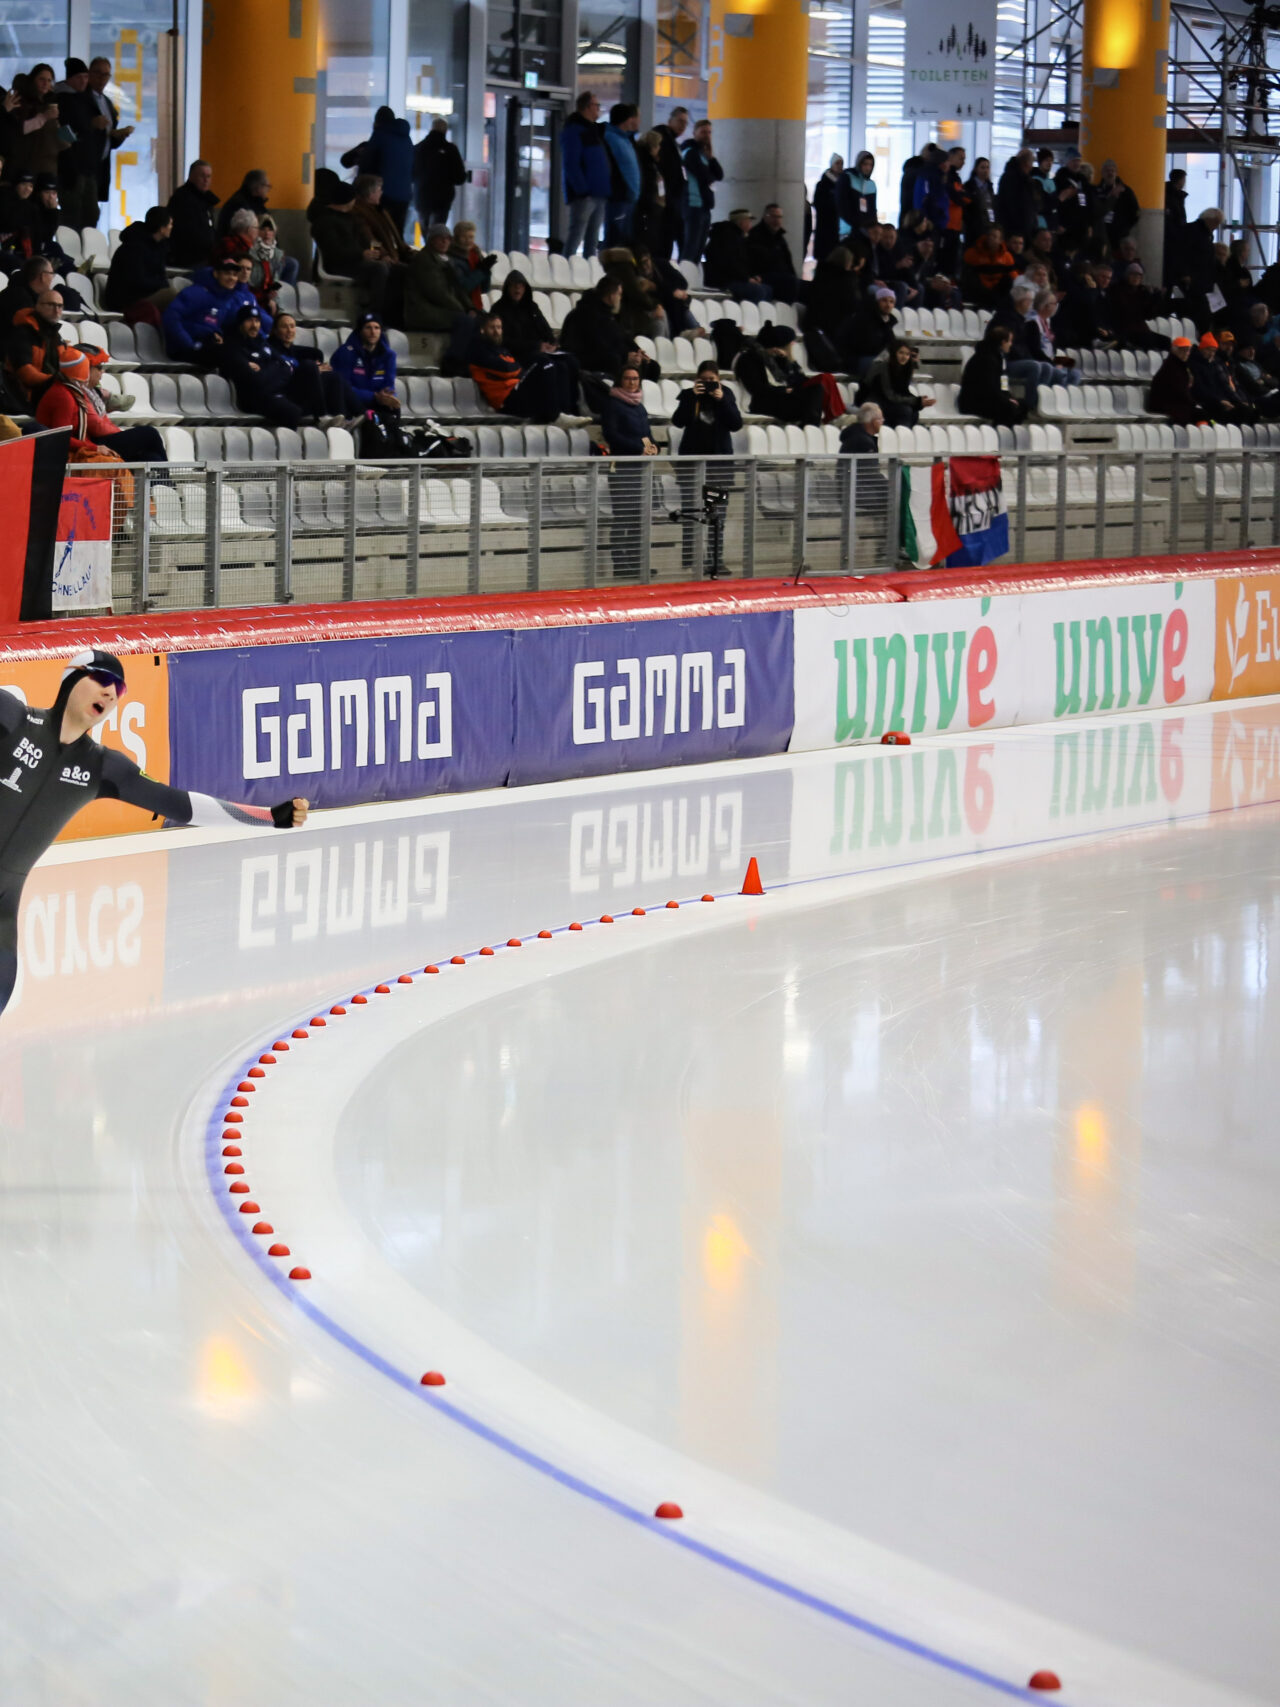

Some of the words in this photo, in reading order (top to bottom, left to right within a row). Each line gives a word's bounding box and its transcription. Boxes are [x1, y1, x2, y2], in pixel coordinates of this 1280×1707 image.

[910, 69, 988, 81] TOILETTEN
[12, 746, 39, 769] BAU
[19, 736, 43, 760] B&O
[61, 765, 91, 782] a&o
